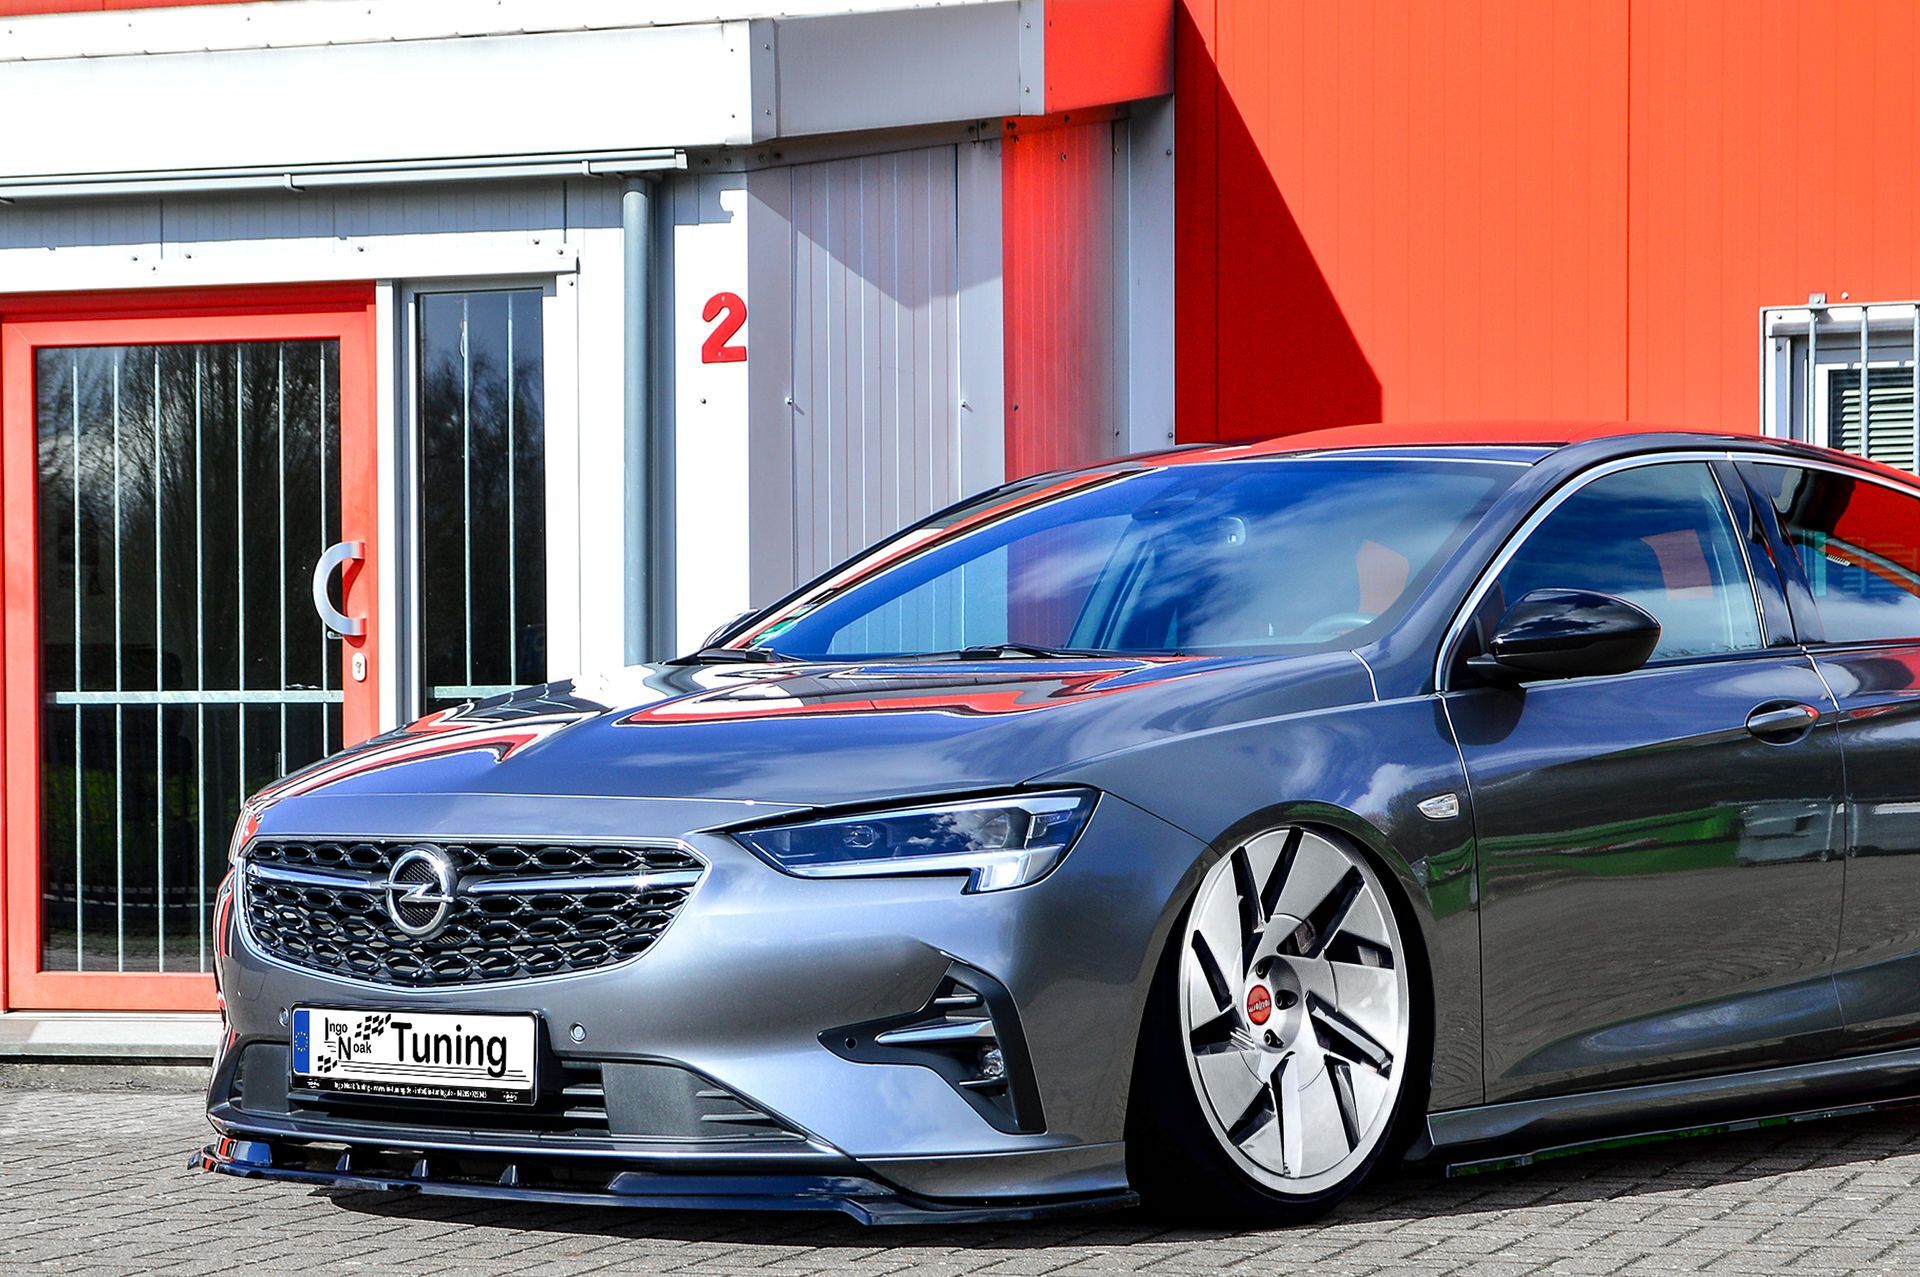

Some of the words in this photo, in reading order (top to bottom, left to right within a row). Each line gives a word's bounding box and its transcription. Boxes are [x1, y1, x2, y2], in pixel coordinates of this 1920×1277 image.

[702, 292, 747, 364] 2
[324, 1017, 348, 1041] Ingo
[338, 1036, 372, 1061] Noak
[390, 1021, 507, 1078] Tuning
